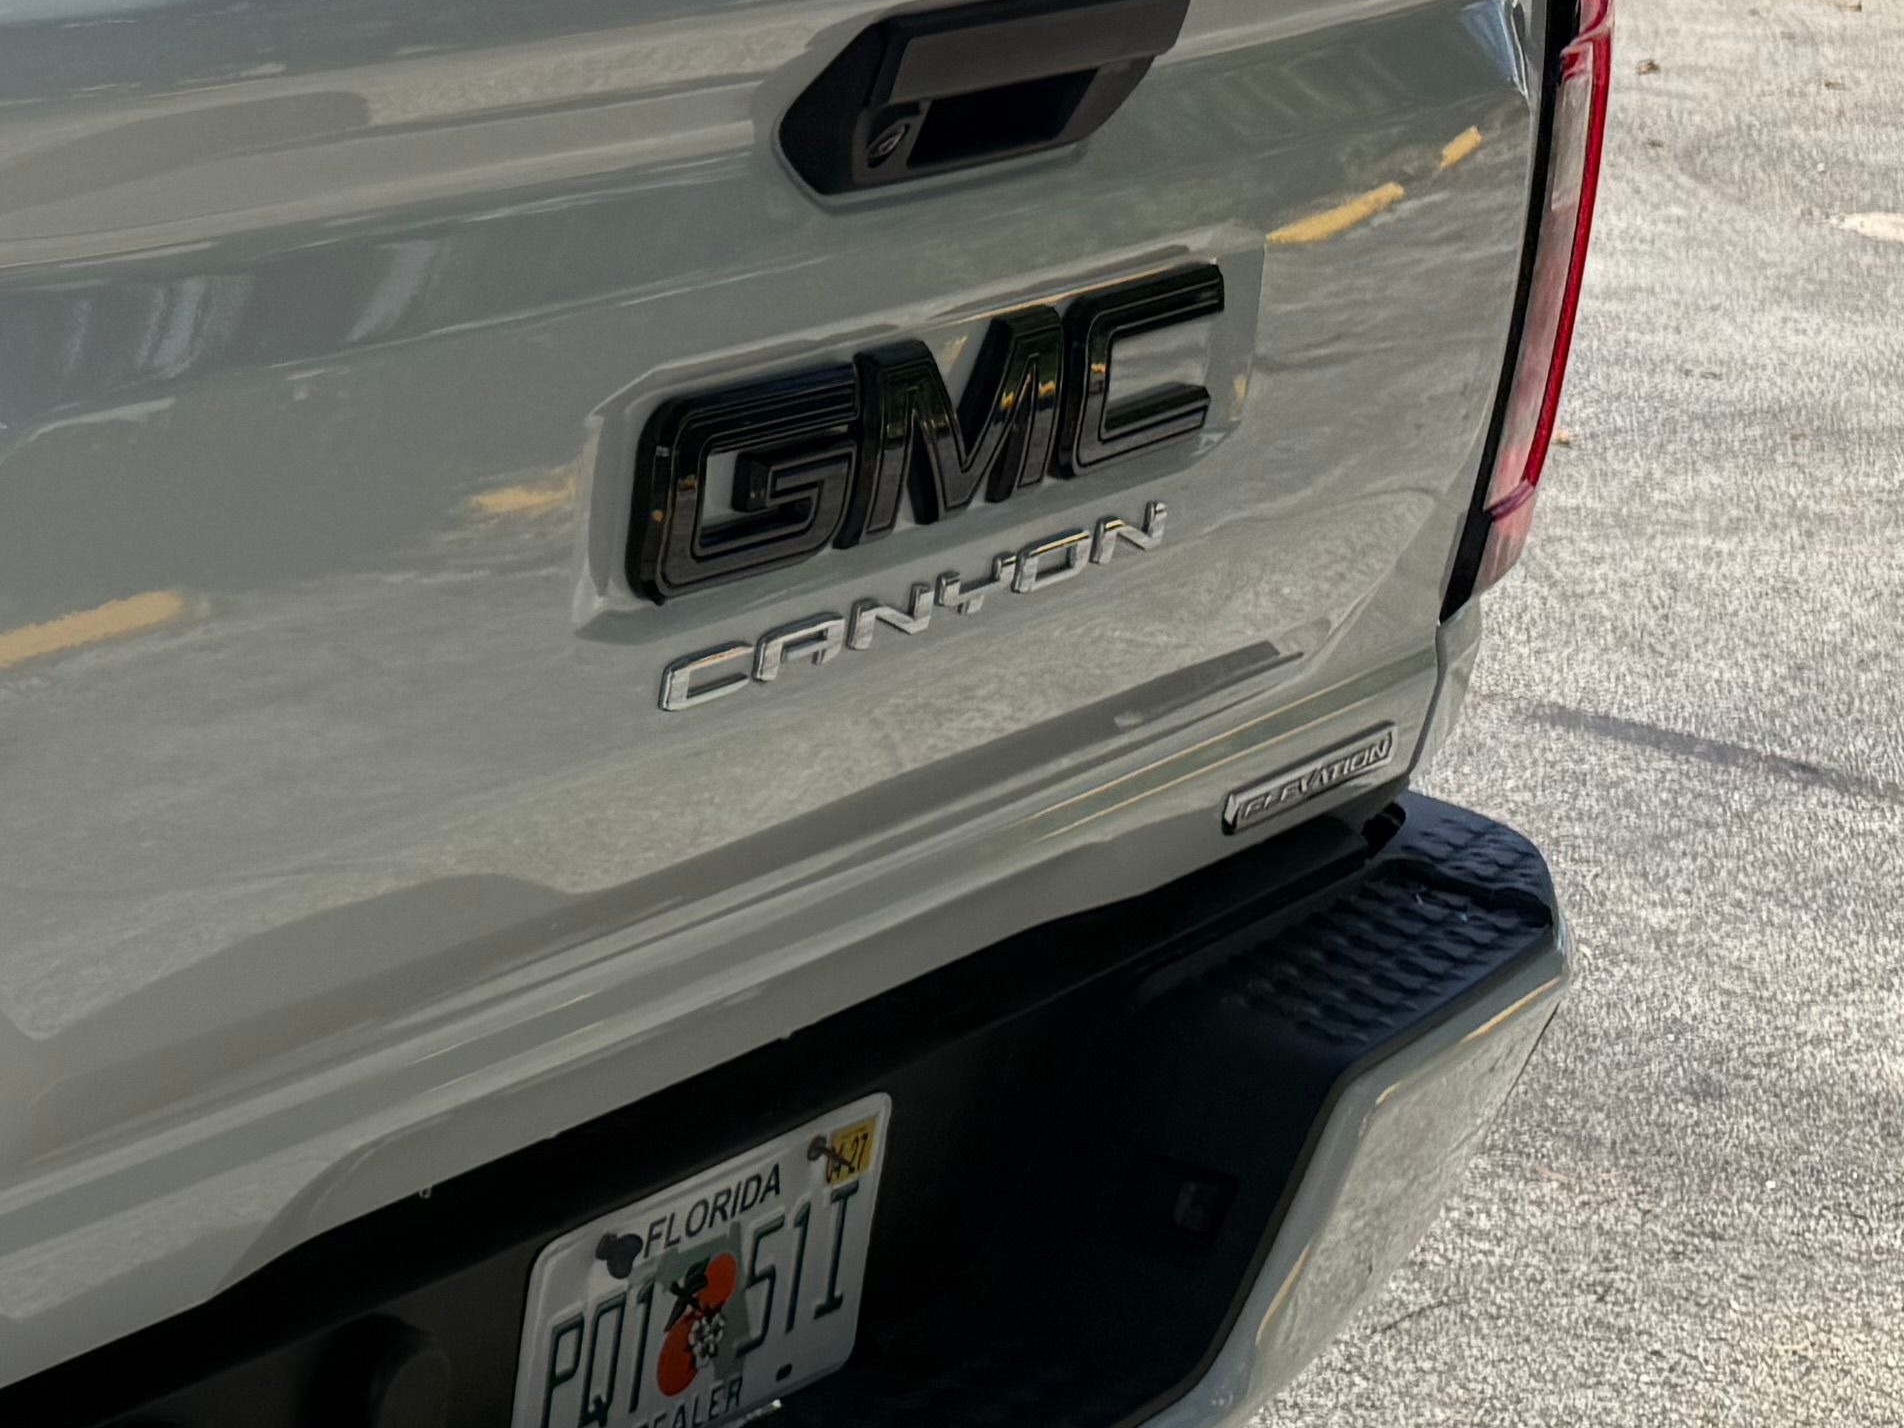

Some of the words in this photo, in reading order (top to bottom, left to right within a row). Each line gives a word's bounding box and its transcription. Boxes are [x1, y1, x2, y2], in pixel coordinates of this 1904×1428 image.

[626, 260, 1226, 606] GMC
[657, 500, 1168, 713] CANYON
[1241, 734, 1392, 821] ELEVATION
[643, 1162, 782, 1260] FLORIDA
